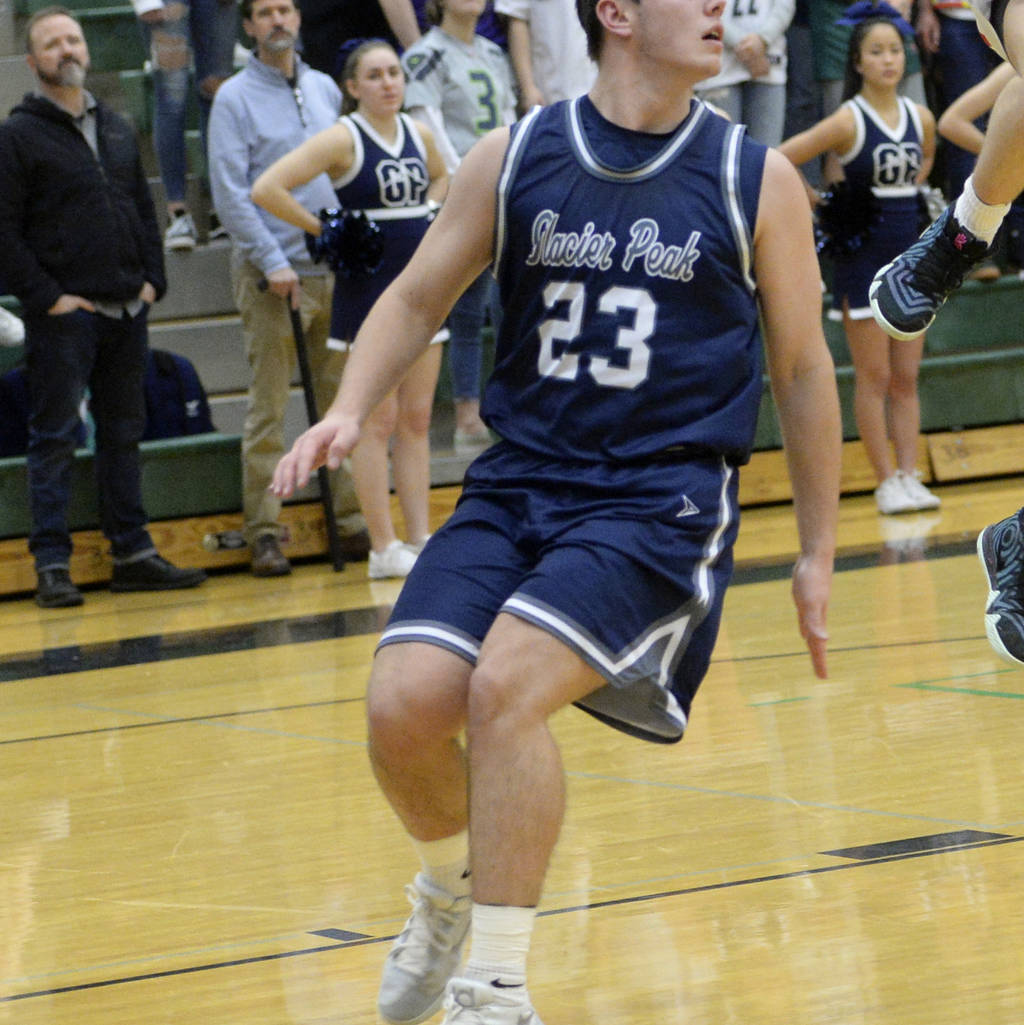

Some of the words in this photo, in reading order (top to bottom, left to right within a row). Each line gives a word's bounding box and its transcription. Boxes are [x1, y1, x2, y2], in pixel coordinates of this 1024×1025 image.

[469, 69, 499, 136] 3
[375, 158, 429, 208] GP
[526, 209, 616, 271] Glacier
[621, 218, 702, 282] Peak
[537, 281, 657, 388] 23
